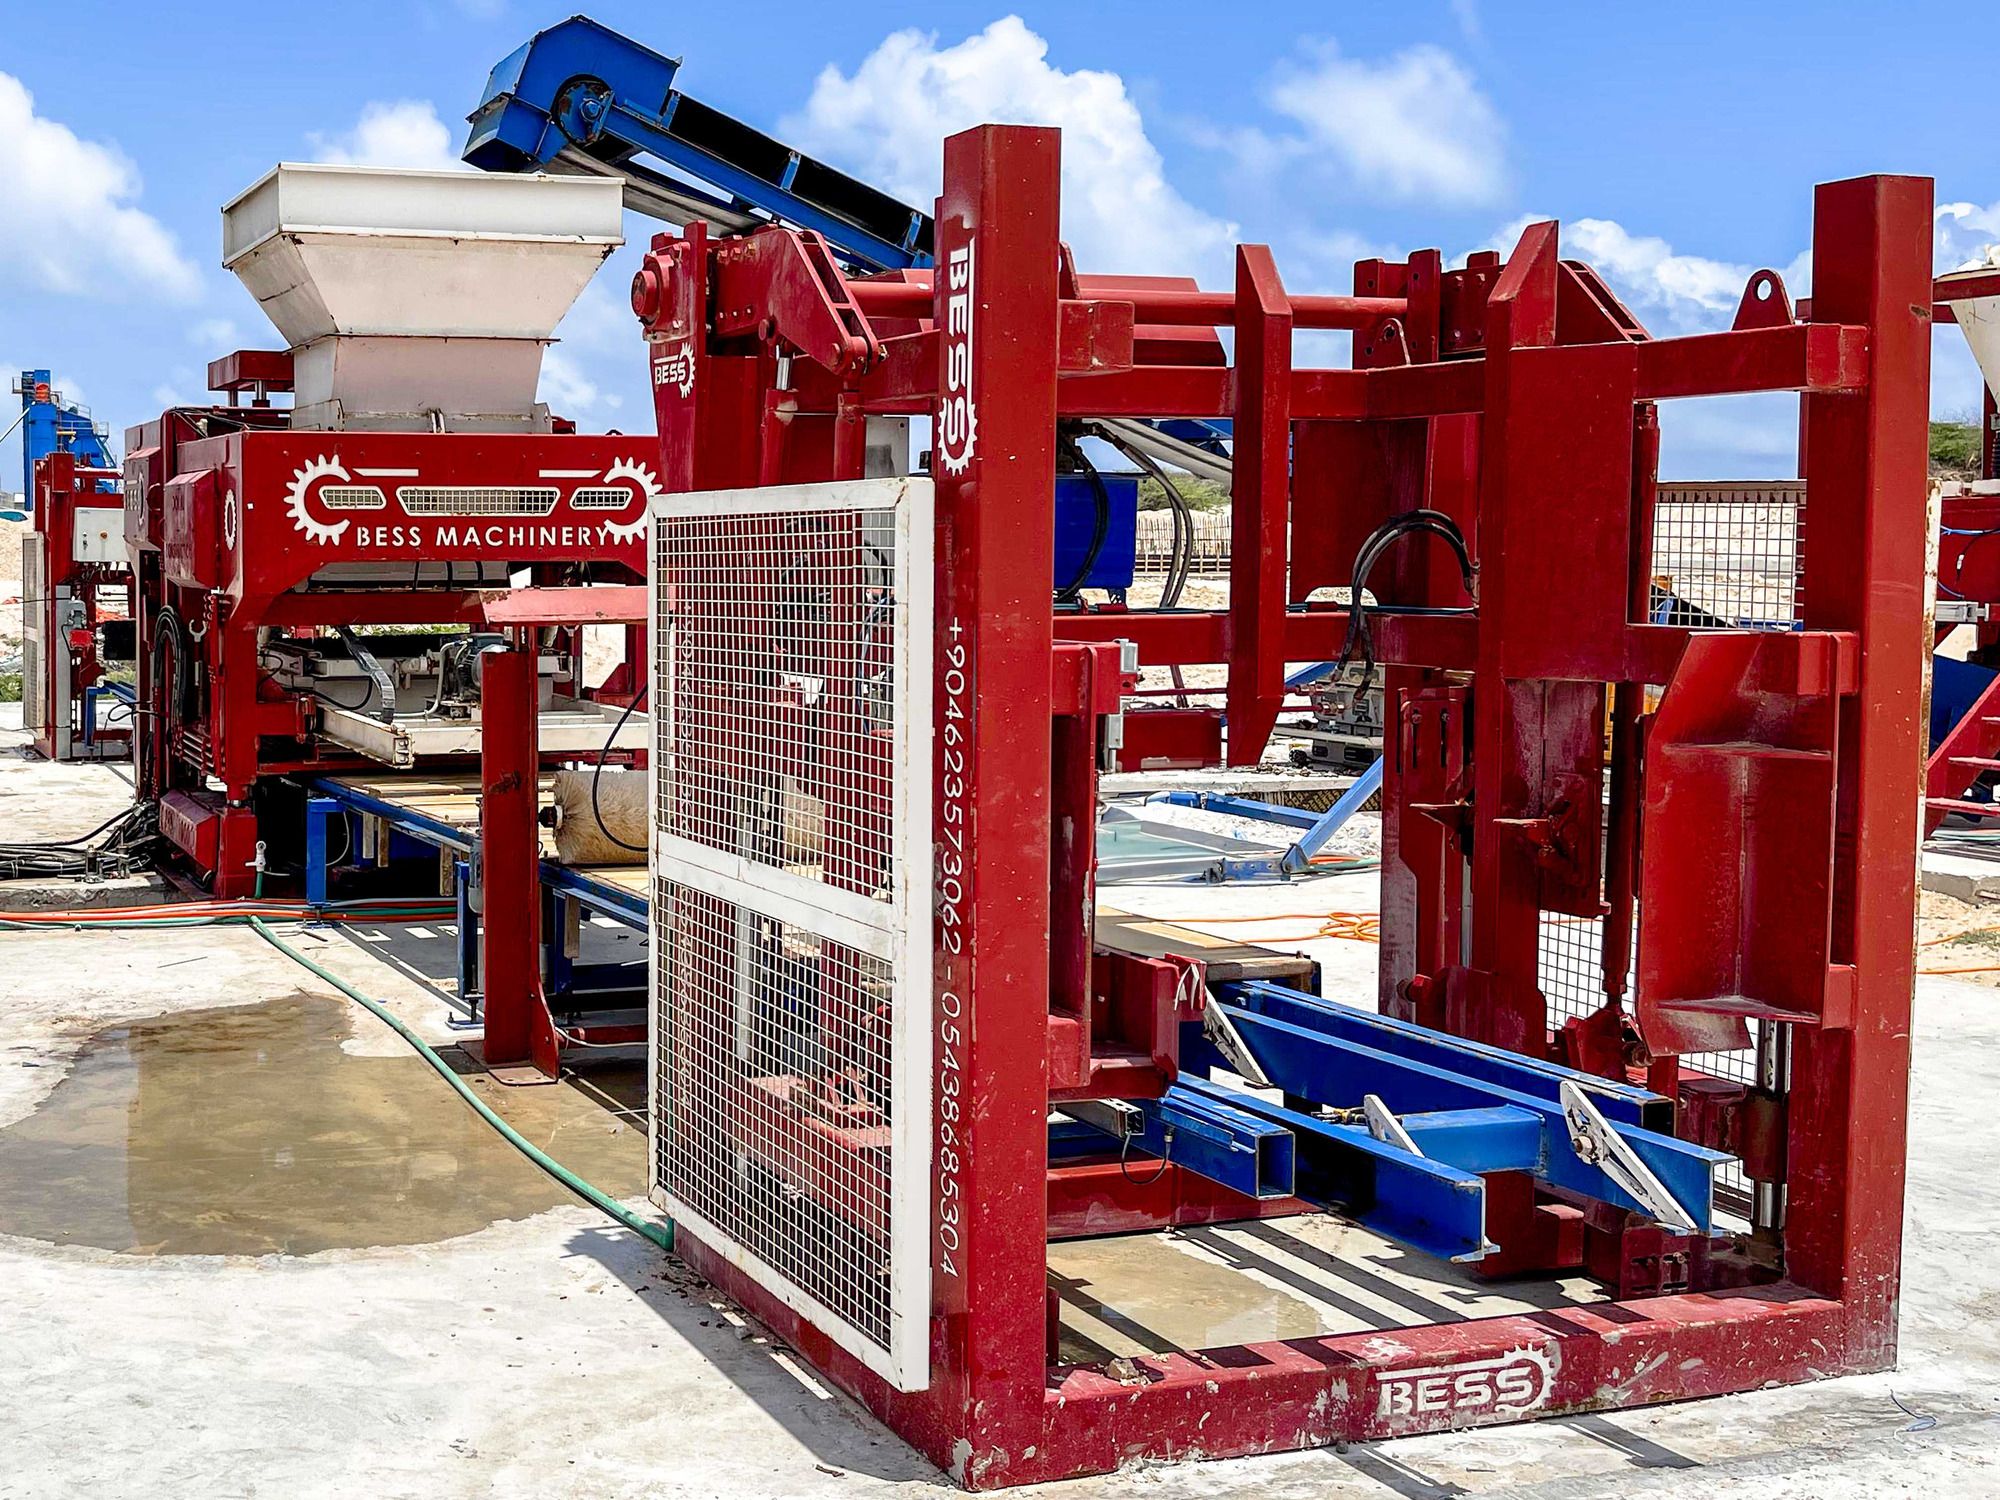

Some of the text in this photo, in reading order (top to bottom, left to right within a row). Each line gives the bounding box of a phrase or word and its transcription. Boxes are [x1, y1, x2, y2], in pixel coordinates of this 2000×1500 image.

[654, 361, 686, 385] BESS
[947, 246, 969, 446] BESS
[356, 526, 609, 548] BESS MACHINERY
[942, 616, 965, 955] +904623573062
[939, 991, 962, 1278] 05438685304
[1378, 1366, 1533, 1416] BESS
